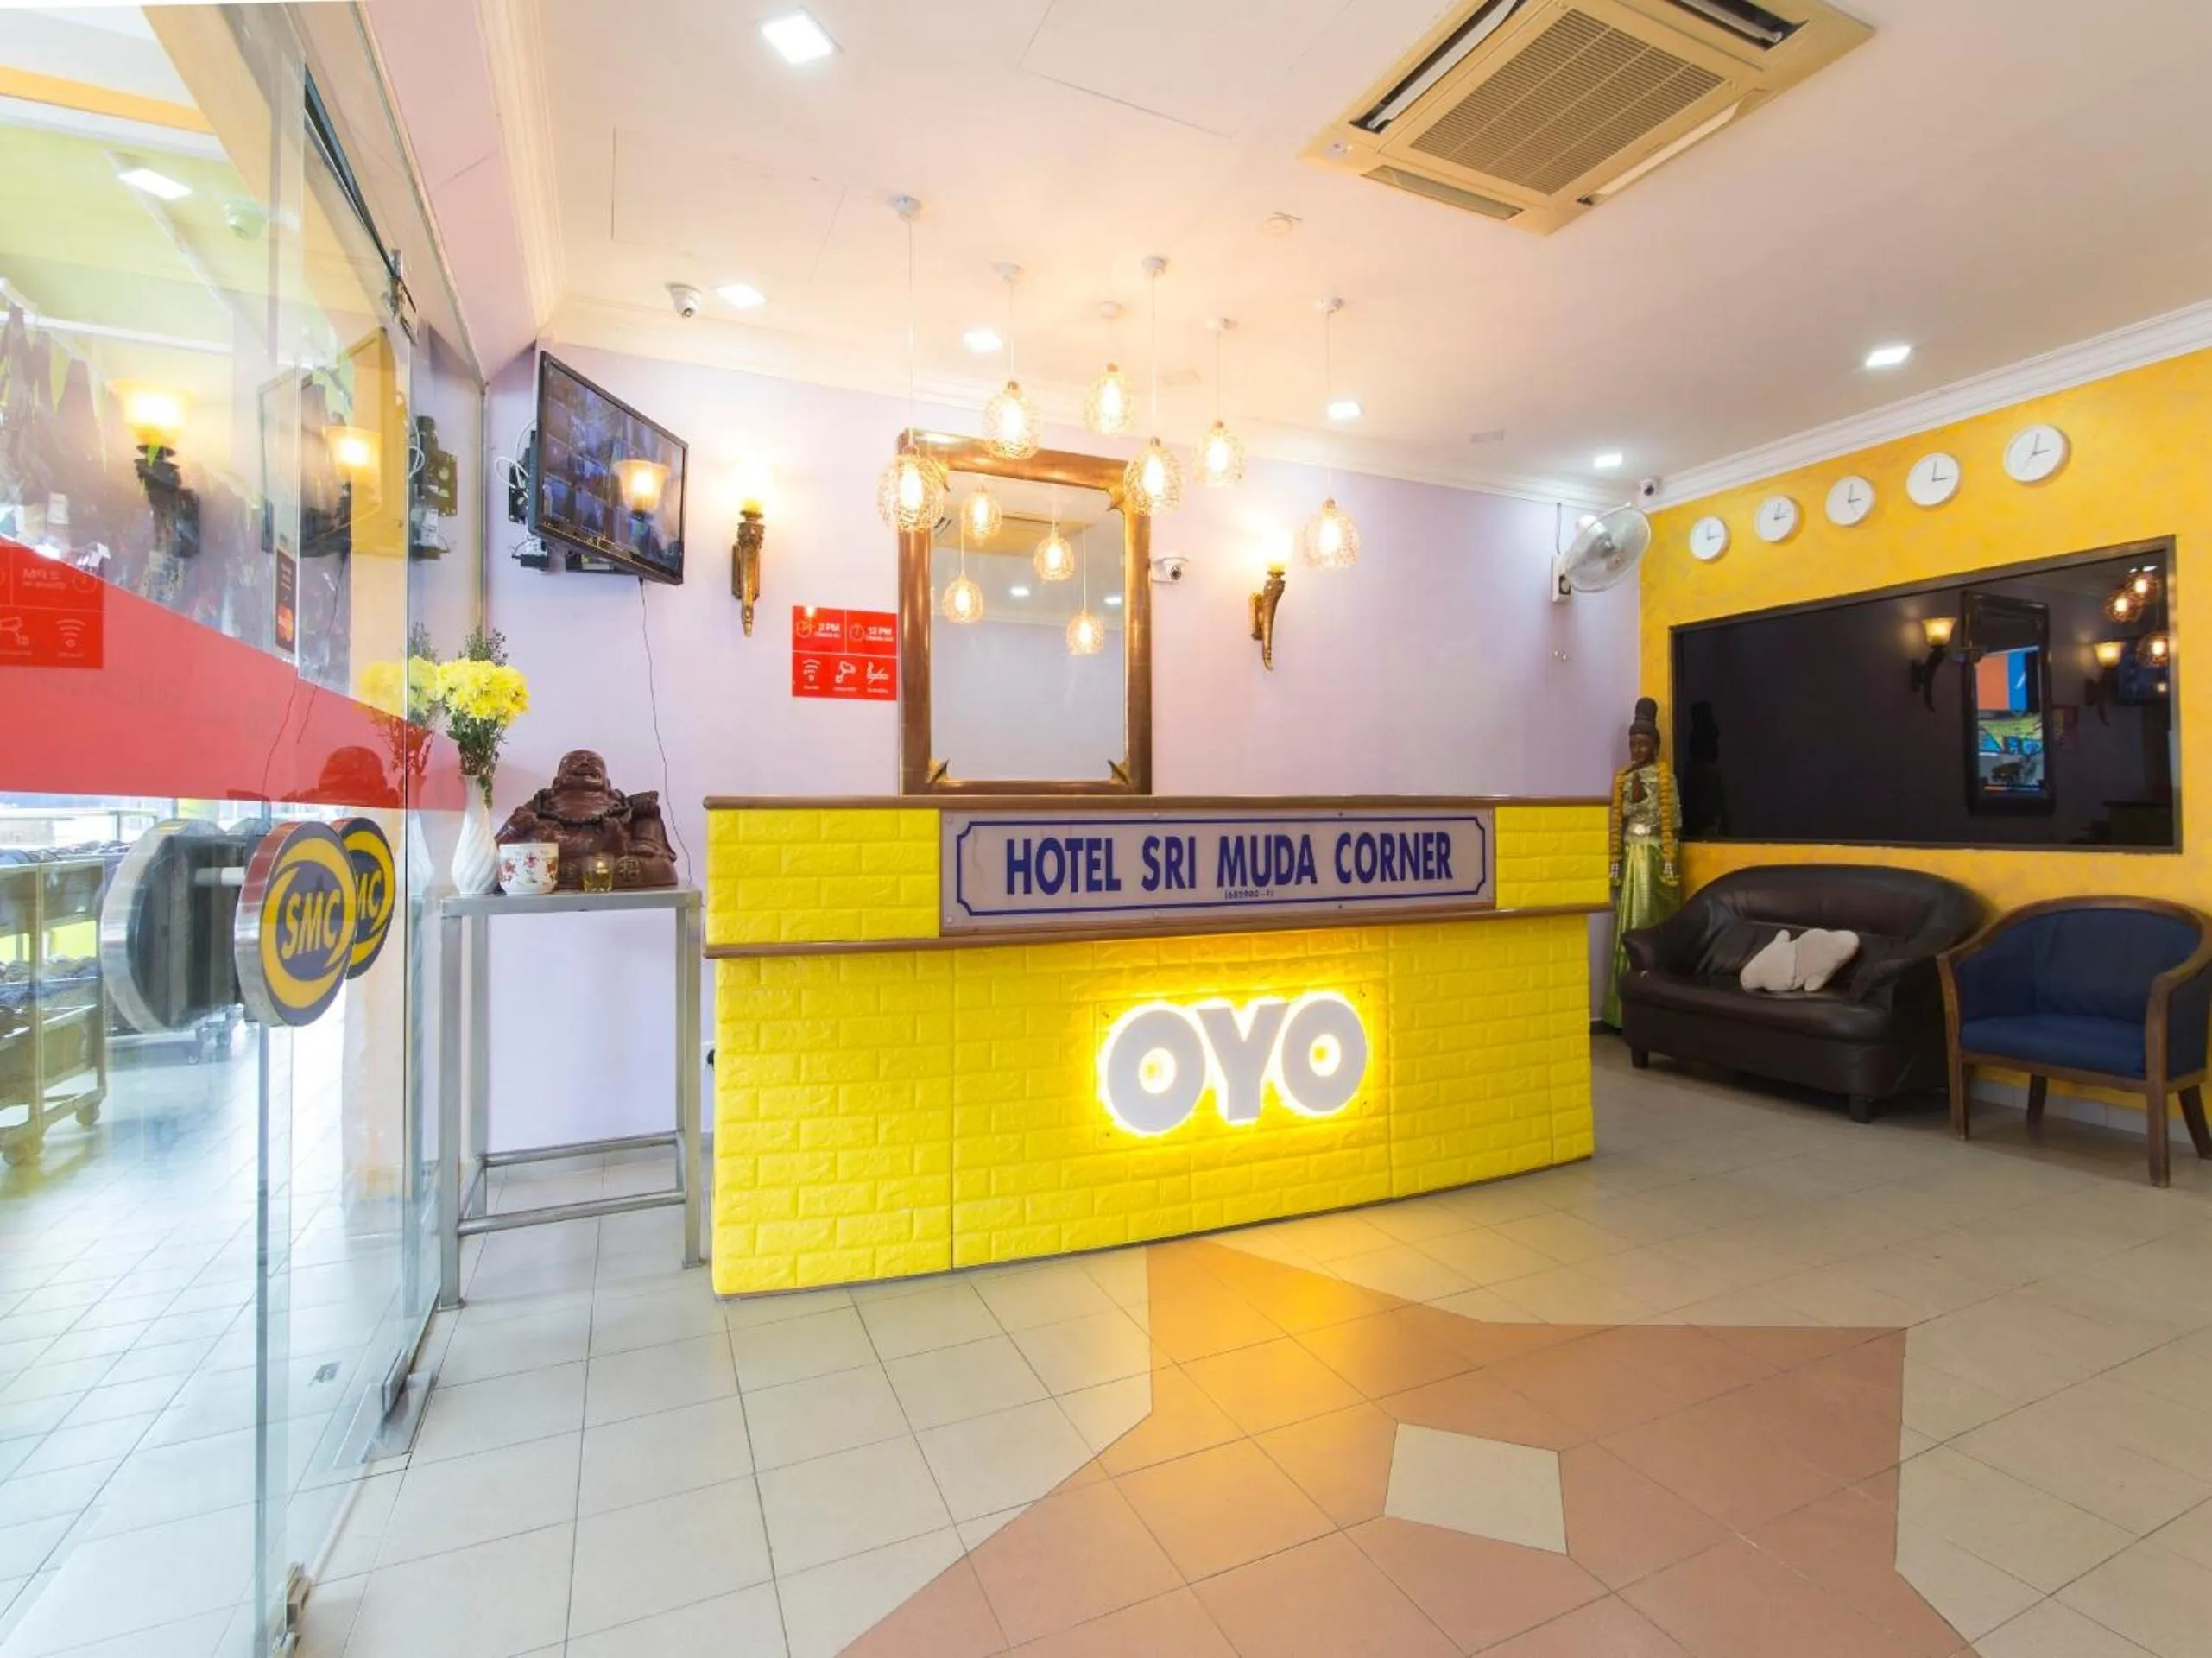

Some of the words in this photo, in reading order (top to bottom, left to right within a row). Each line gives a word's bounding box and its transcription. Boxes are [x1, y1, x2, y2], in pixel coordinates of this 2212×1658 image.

[825, 623, 840, 632] PM
[878, 627, 892, 636] PM
[1006, 838, 1122, 895] HOTEL
[1141, 836, 1196, 891] SRI
[1217, 834, 1318, 888] MUDA
[1335, 832, 1453, 883] CORNER
[356, 869, 382, 921] MC
[281, 888, 342, 960] SMC
[1106, 998, 1368, 1133] OYO
